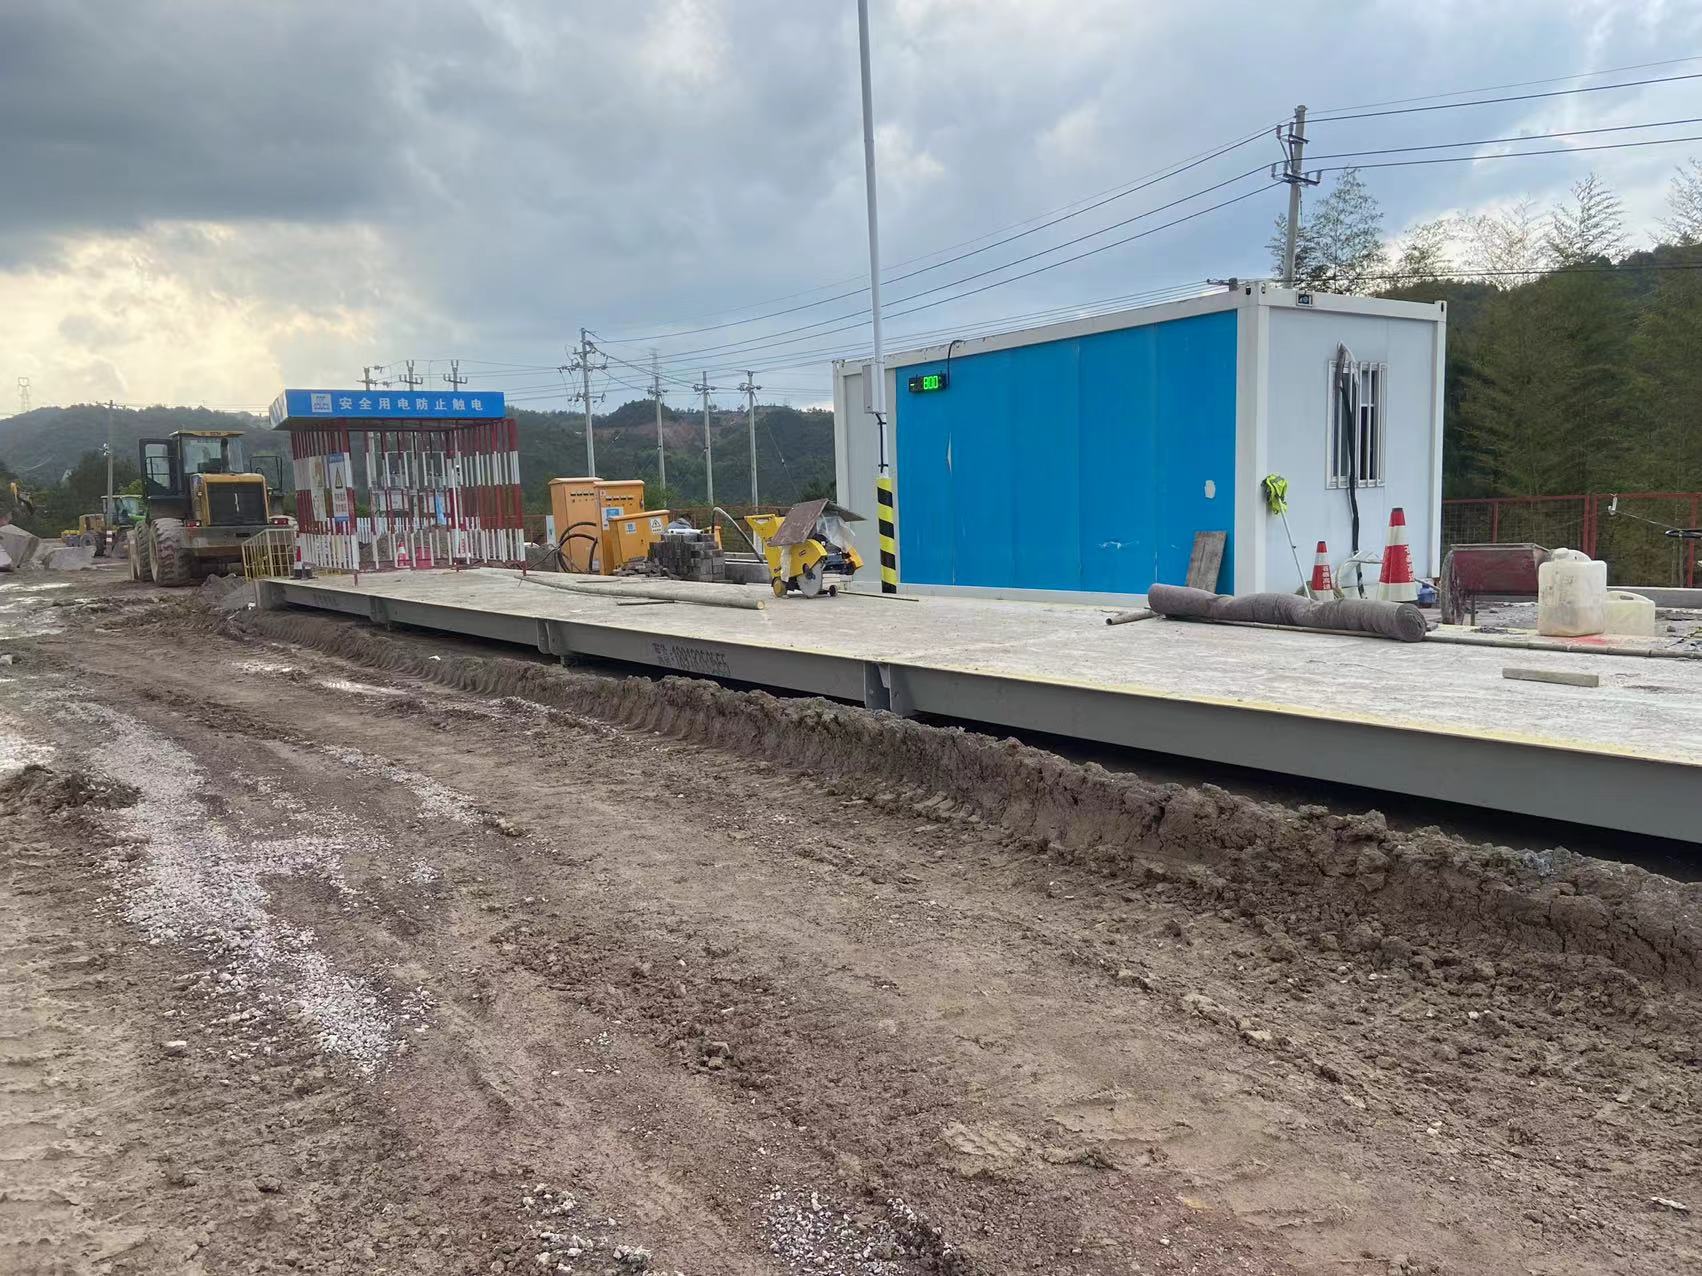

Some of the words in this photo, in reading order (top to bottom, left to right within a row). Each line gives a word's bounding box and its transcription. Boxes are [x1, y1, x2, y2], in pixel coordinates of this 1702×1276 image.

[339, 397, 484, 411] 安全用电防止触电
